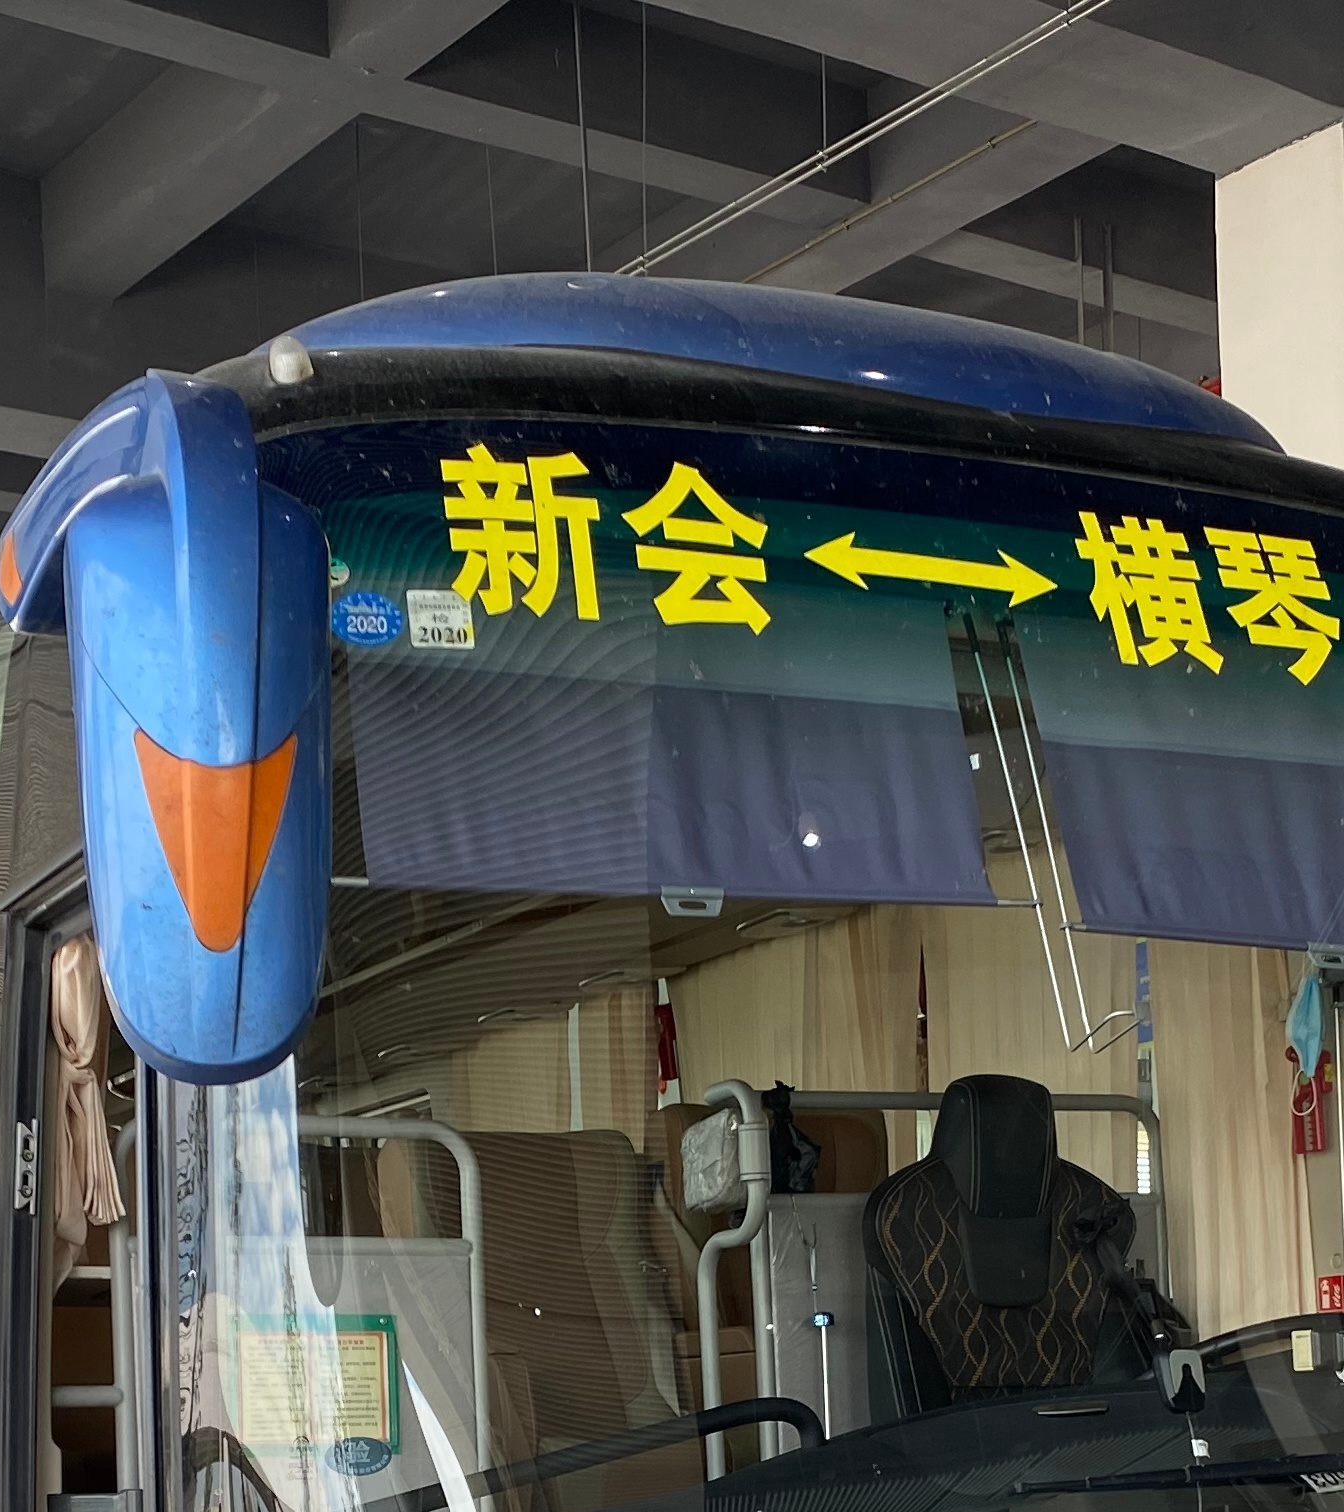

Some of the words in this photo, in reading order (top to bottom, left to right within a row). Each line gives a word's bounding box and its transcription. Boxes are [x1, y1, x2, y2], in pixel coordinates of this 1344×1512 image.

[440, 443, 771, 637] 新会
[347, 615, 387, 634] 2020
[418, 625, 468, 644] 2020
